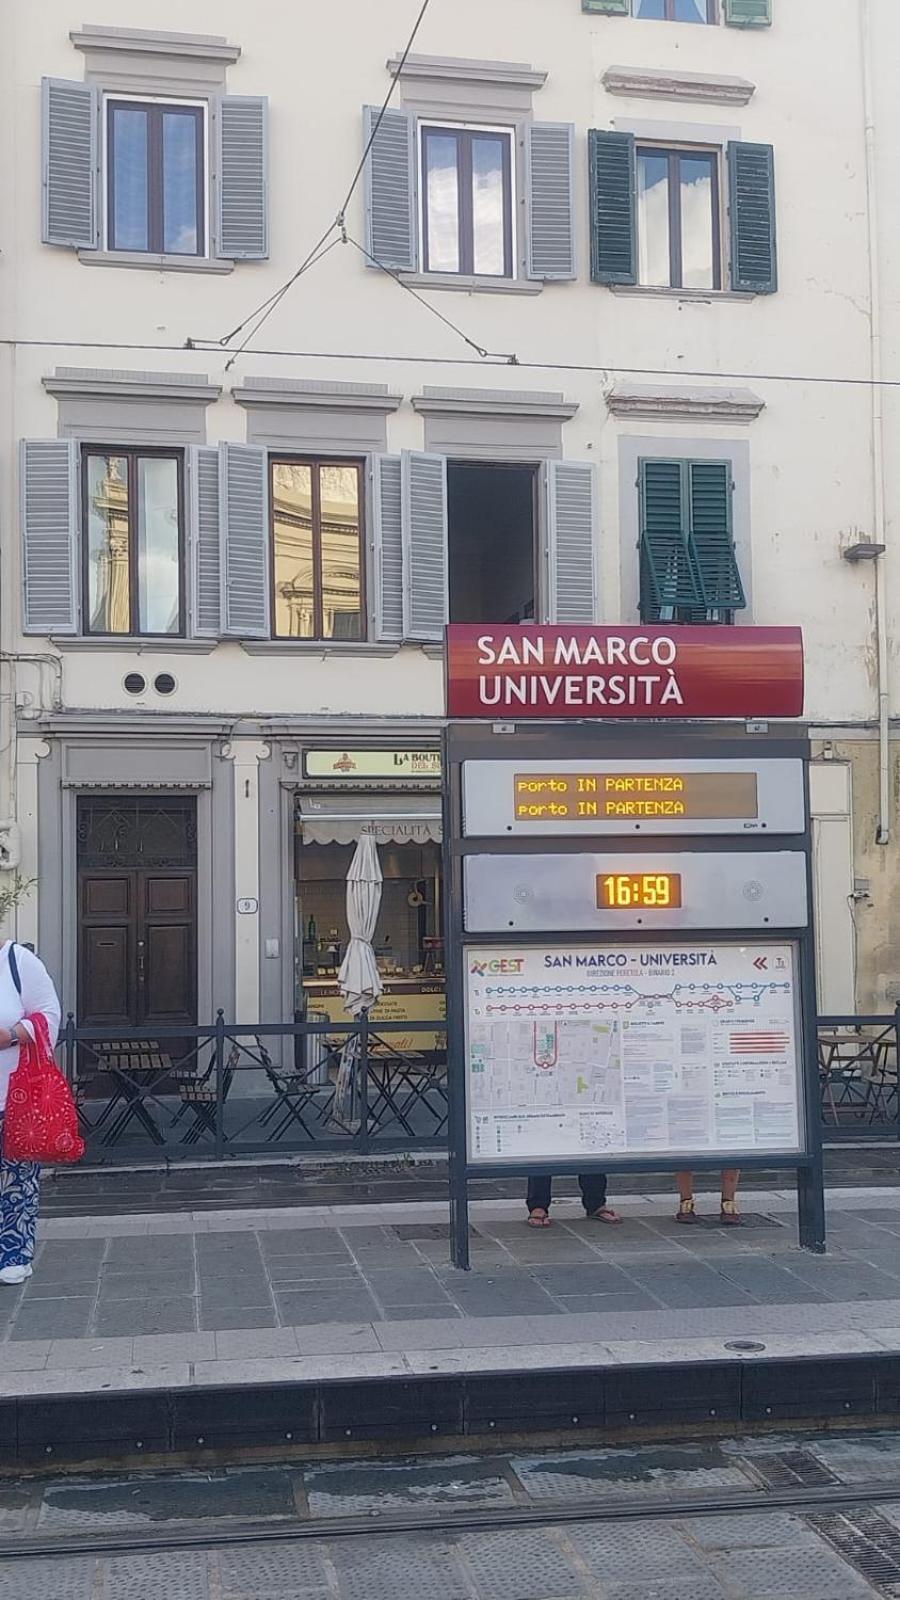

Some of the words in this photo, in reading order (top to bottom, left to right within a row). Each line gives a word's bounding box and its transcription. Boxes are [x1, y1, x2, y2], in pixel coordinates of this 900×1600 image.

[477, 636, 544, 665] SAN
[554, 636, 677, 665] MARCO
[479, 669, 684, 705] UNIVERSITÀ
[411, 753, 441, 761] BOUTI
[518, 779, 567, 793] porto
[578, 778, 597, 792] IN
[605, 778, 684, 792] PARTENZA
[518, 803, 568, 816] porto
[578, 802, 597, 815] IN
[606, 801, 685, 815] PARTENZA
[604, 876, 670, 905] 16:59
[488, 958, 525, 973] GEST
[544, 954, 572, 968] SAN
[576, 954, 627, 967] MARCO
[640, 950, 718, 966] UNIVERSITÀ
